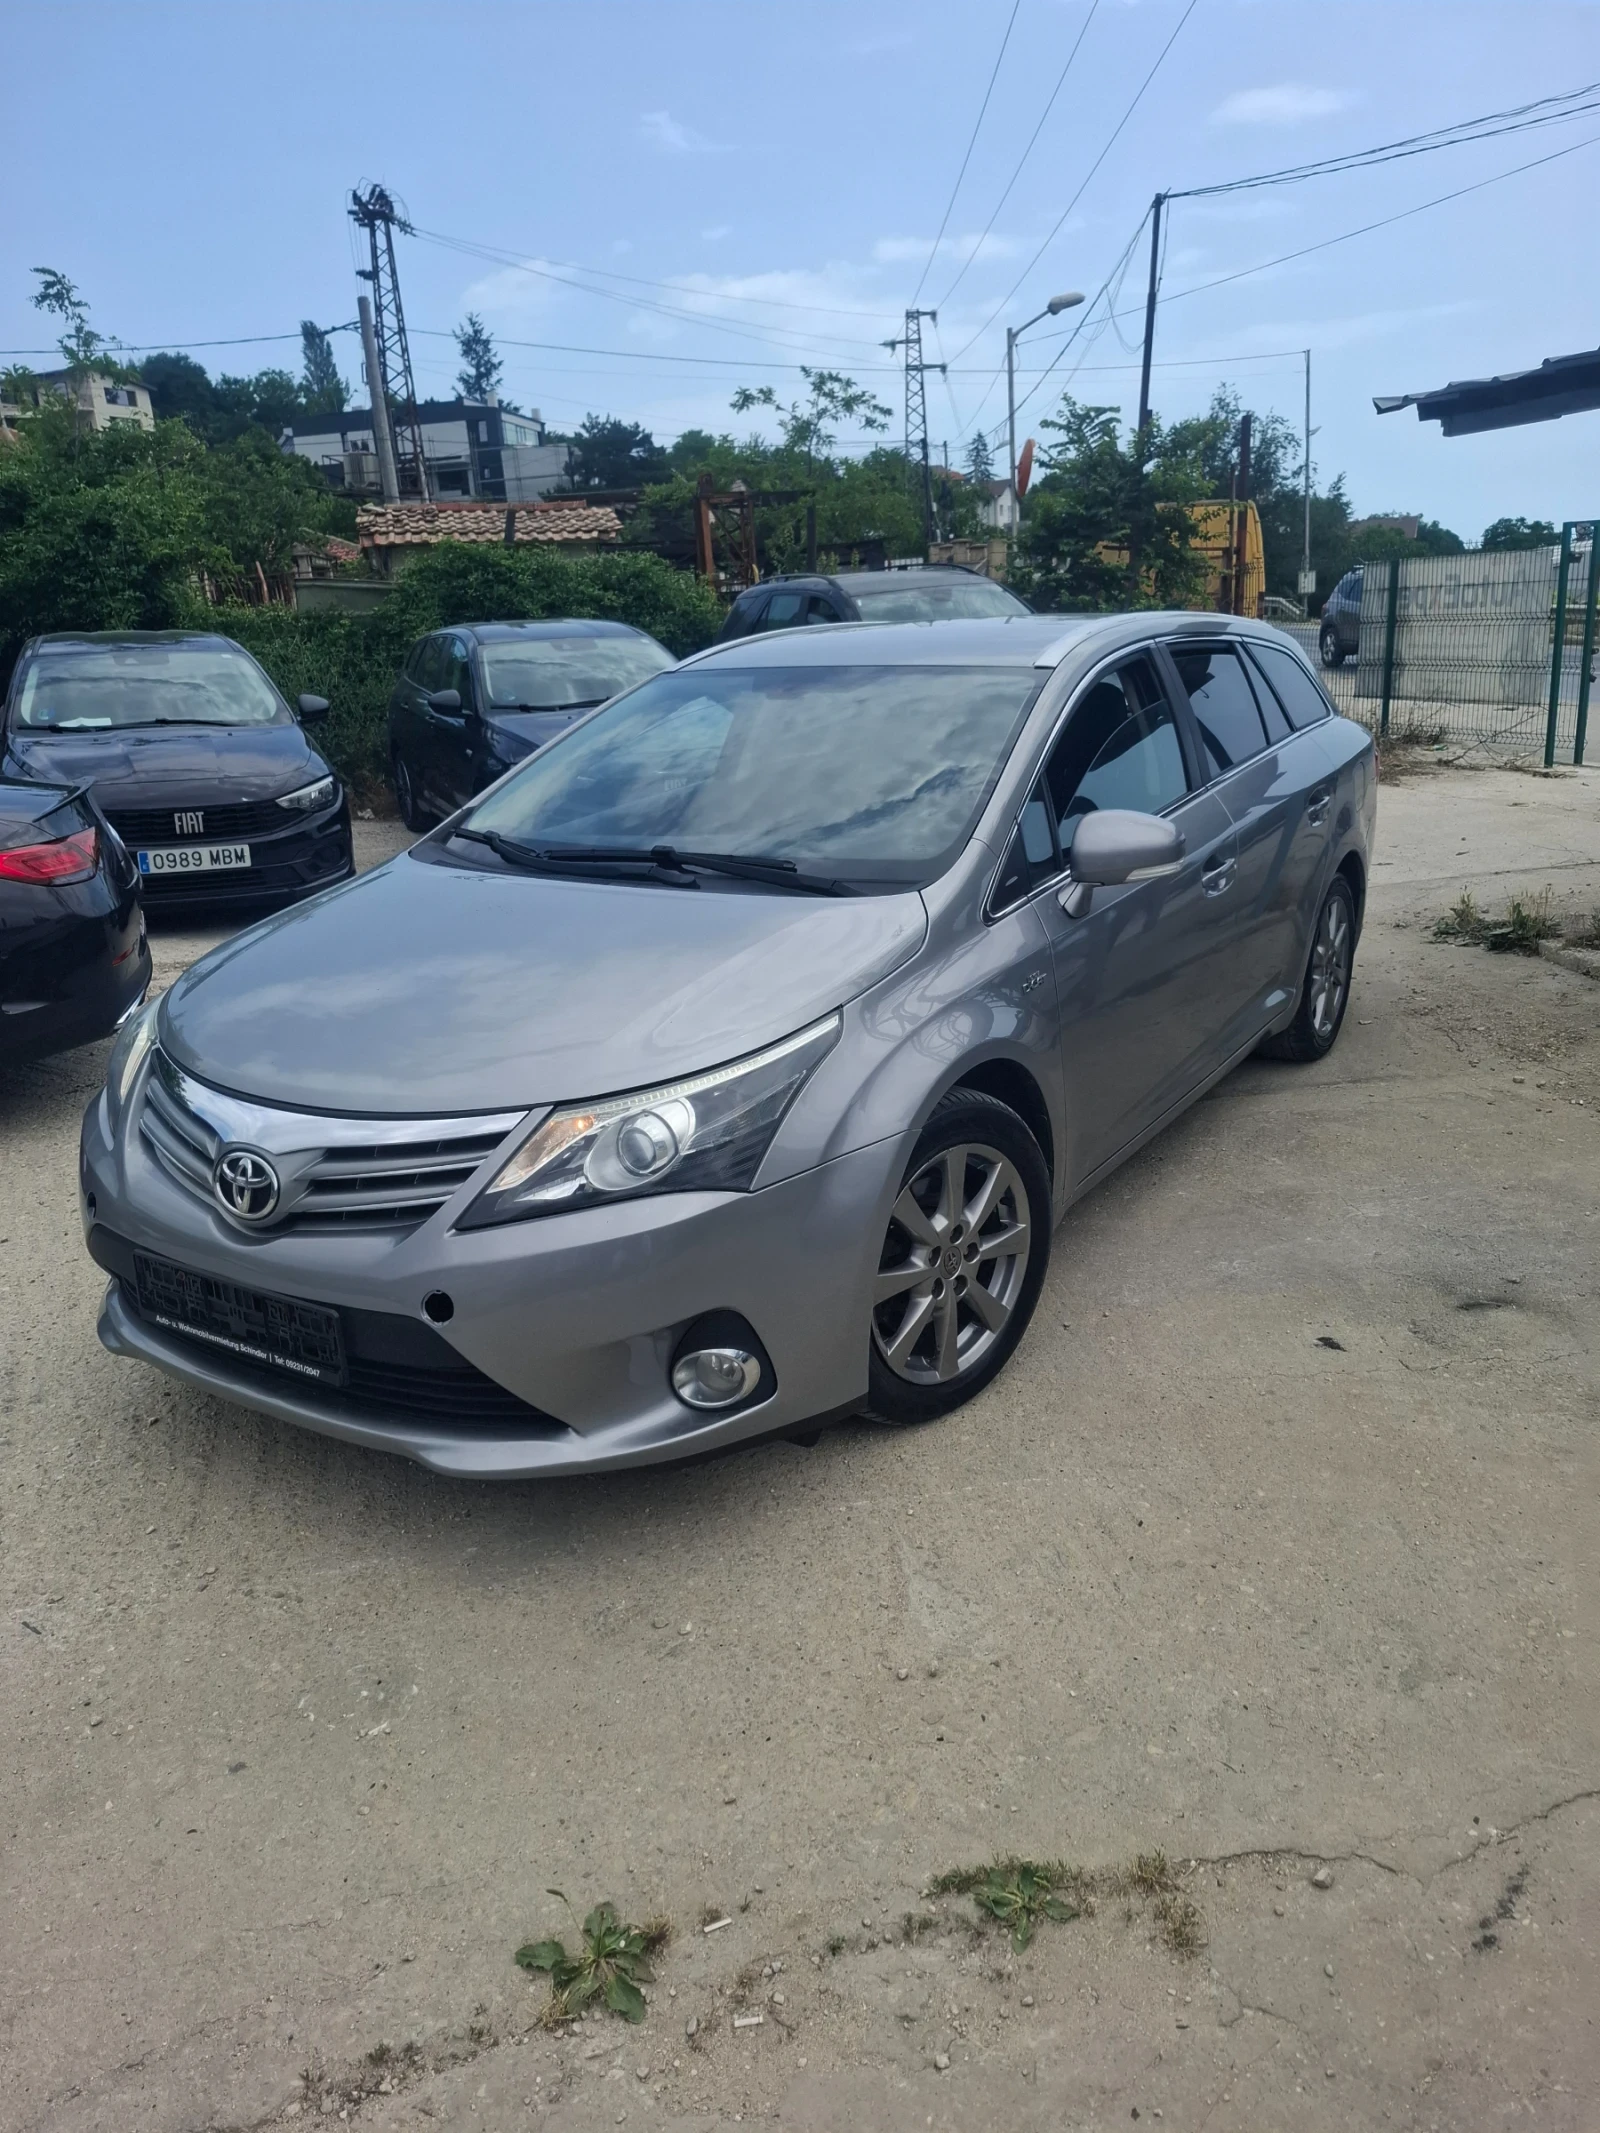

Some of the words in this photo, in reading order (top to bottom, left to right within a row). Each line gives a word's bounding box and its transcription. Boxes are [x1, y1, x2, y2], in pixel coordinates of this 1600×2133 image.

[174, 811, 204, 834] FIAT
[153, 851, 203, 870] 0989
[209, 847, 246, 867] MBM
[240, 1343, 267, 1360] Schindler
